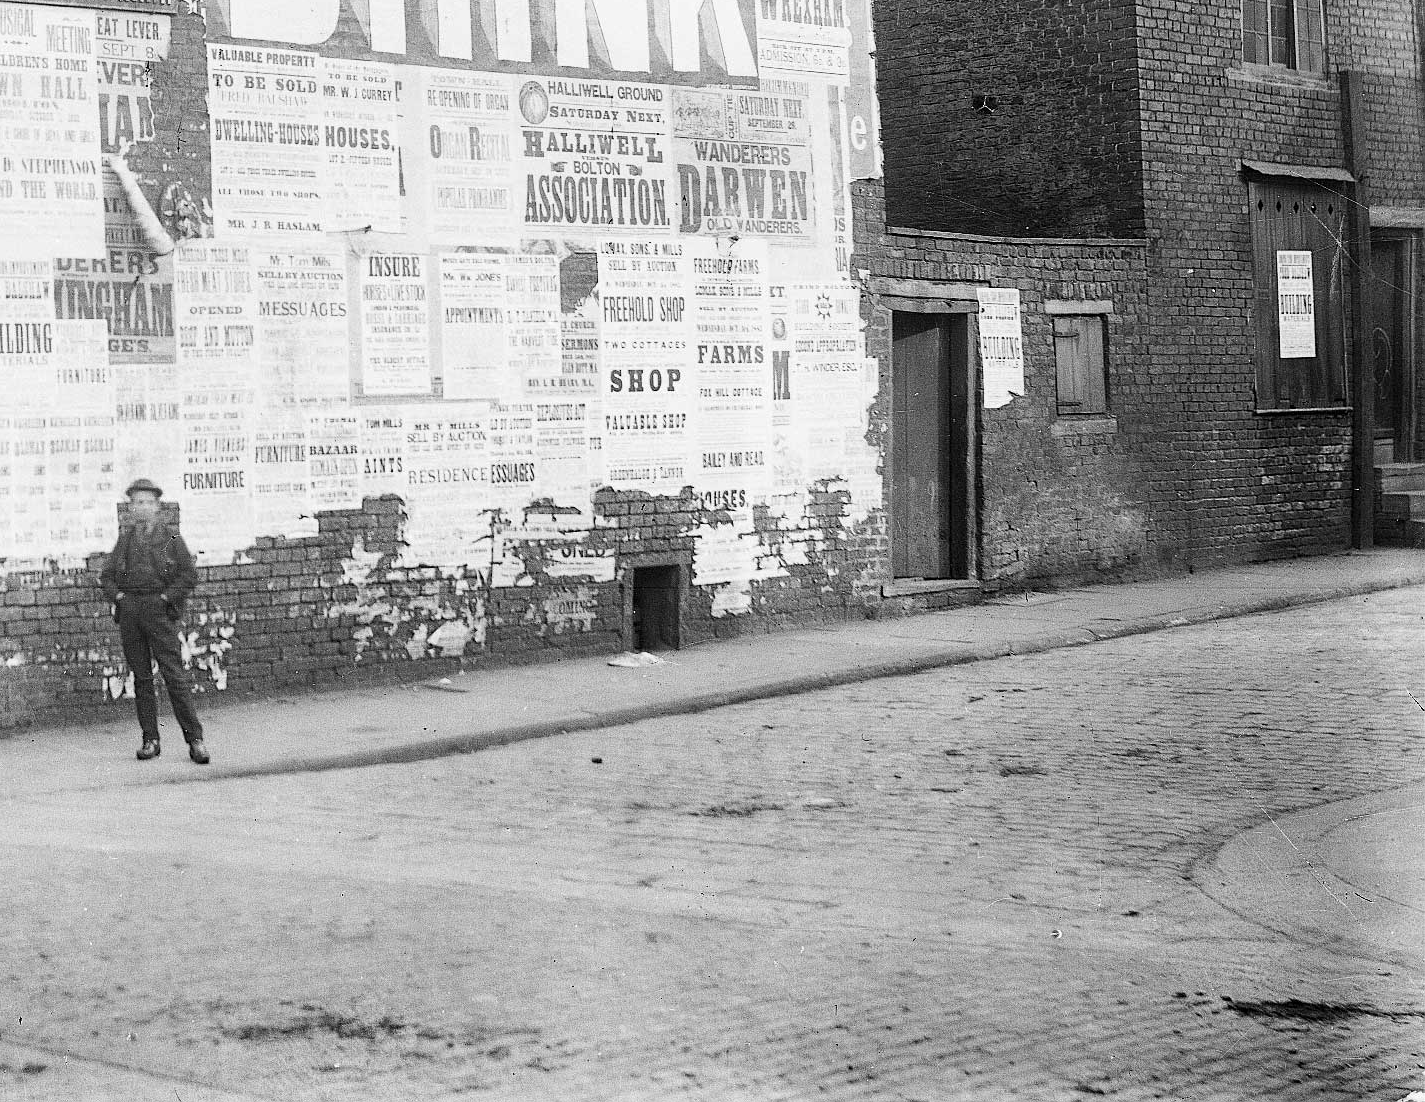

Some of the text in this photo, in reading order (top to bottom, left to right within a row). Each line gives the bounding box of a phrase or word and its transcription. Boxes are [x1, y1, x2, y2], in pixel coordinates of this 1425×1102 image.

[46, 24, 92, 55] MEETING
[55, 58, 88, 73] HOME
[211, 48, 316, 68] VALUABLE PROPERTY
[213, 73, 318, 94] TO BE SOLD
[328, 73, 387, 84] TO BE SOLD
[361, 88, 393, 102] CURREY
[548, 81, 663, 102] HALLIWELL GROUND
[473, 93, 509, 111] OF ORGAN
[739, 95, 779, 118] SATURDAY
[550, 105, 619, 120] SATURDAY
[726, 93, 735, 139] CUP TIE
[215, 118, 320, 148] DWELLING-HOUSES
[747, 118, 784, 130] SEPTEMBER
[850, 115, 868, 150] e
[429, 124, 512, 163] ORGAN RECITAL
[523, 130, 664, 164] HALLIWELL
[694, 140, 792, 166] WANDERERS
[22, 157, 97, 175] STEPHENSON
[574, 160, 621, 176] BOLTON
[21, 180, 46, 200] THE
[677, 163, 808, 234] DARWEN
[524, 174, 670, 226] ASSOCIATION.
[706, 218, 733, 232] OLD
[662, 244, 683, 257] MILLS
[368, 256, 421, 278] INSURE
[609, 260, 677, 273] SELL BY AUCTION
[693, 258, 734, 275] FREEHOLD
[257, 271, 344, 281] SELL AUCTION
[189, 305, 243, 316] OPENED
[259, 301, 347, 317] MESSUAGES
[603, 296, 685, 323] FREEHOLD SHOP
[1280, 294, 1312, 315] BUILDING
[445, 307, 504, 324] APPOINTMENTS
[604, 341, 686, 349] TWO COTTAGES
[697, 345, 765, 364] FARMS
[57, 368, 106, 385] FURNITURE
[610, 369, 681, 393] SHOP
[733, 388, 763, 397] COTTAGE
[450, 422, 480, 430] MILLS
[605, 414, 686, 430] VALUABLE SHOP
[407, 430, 488, 444] SELL AUCTION
[255, 445, 306, 464] FURNITURE
[309, 444, 359, 456] BAZAAR
[703, 451, 743, 468] BAILEY AND
[184, 470, 245, 490] FURNITURE
[408, 467, 489, 485] RESIDENCE
[490, 462, 536, 484] ESSUAGES
